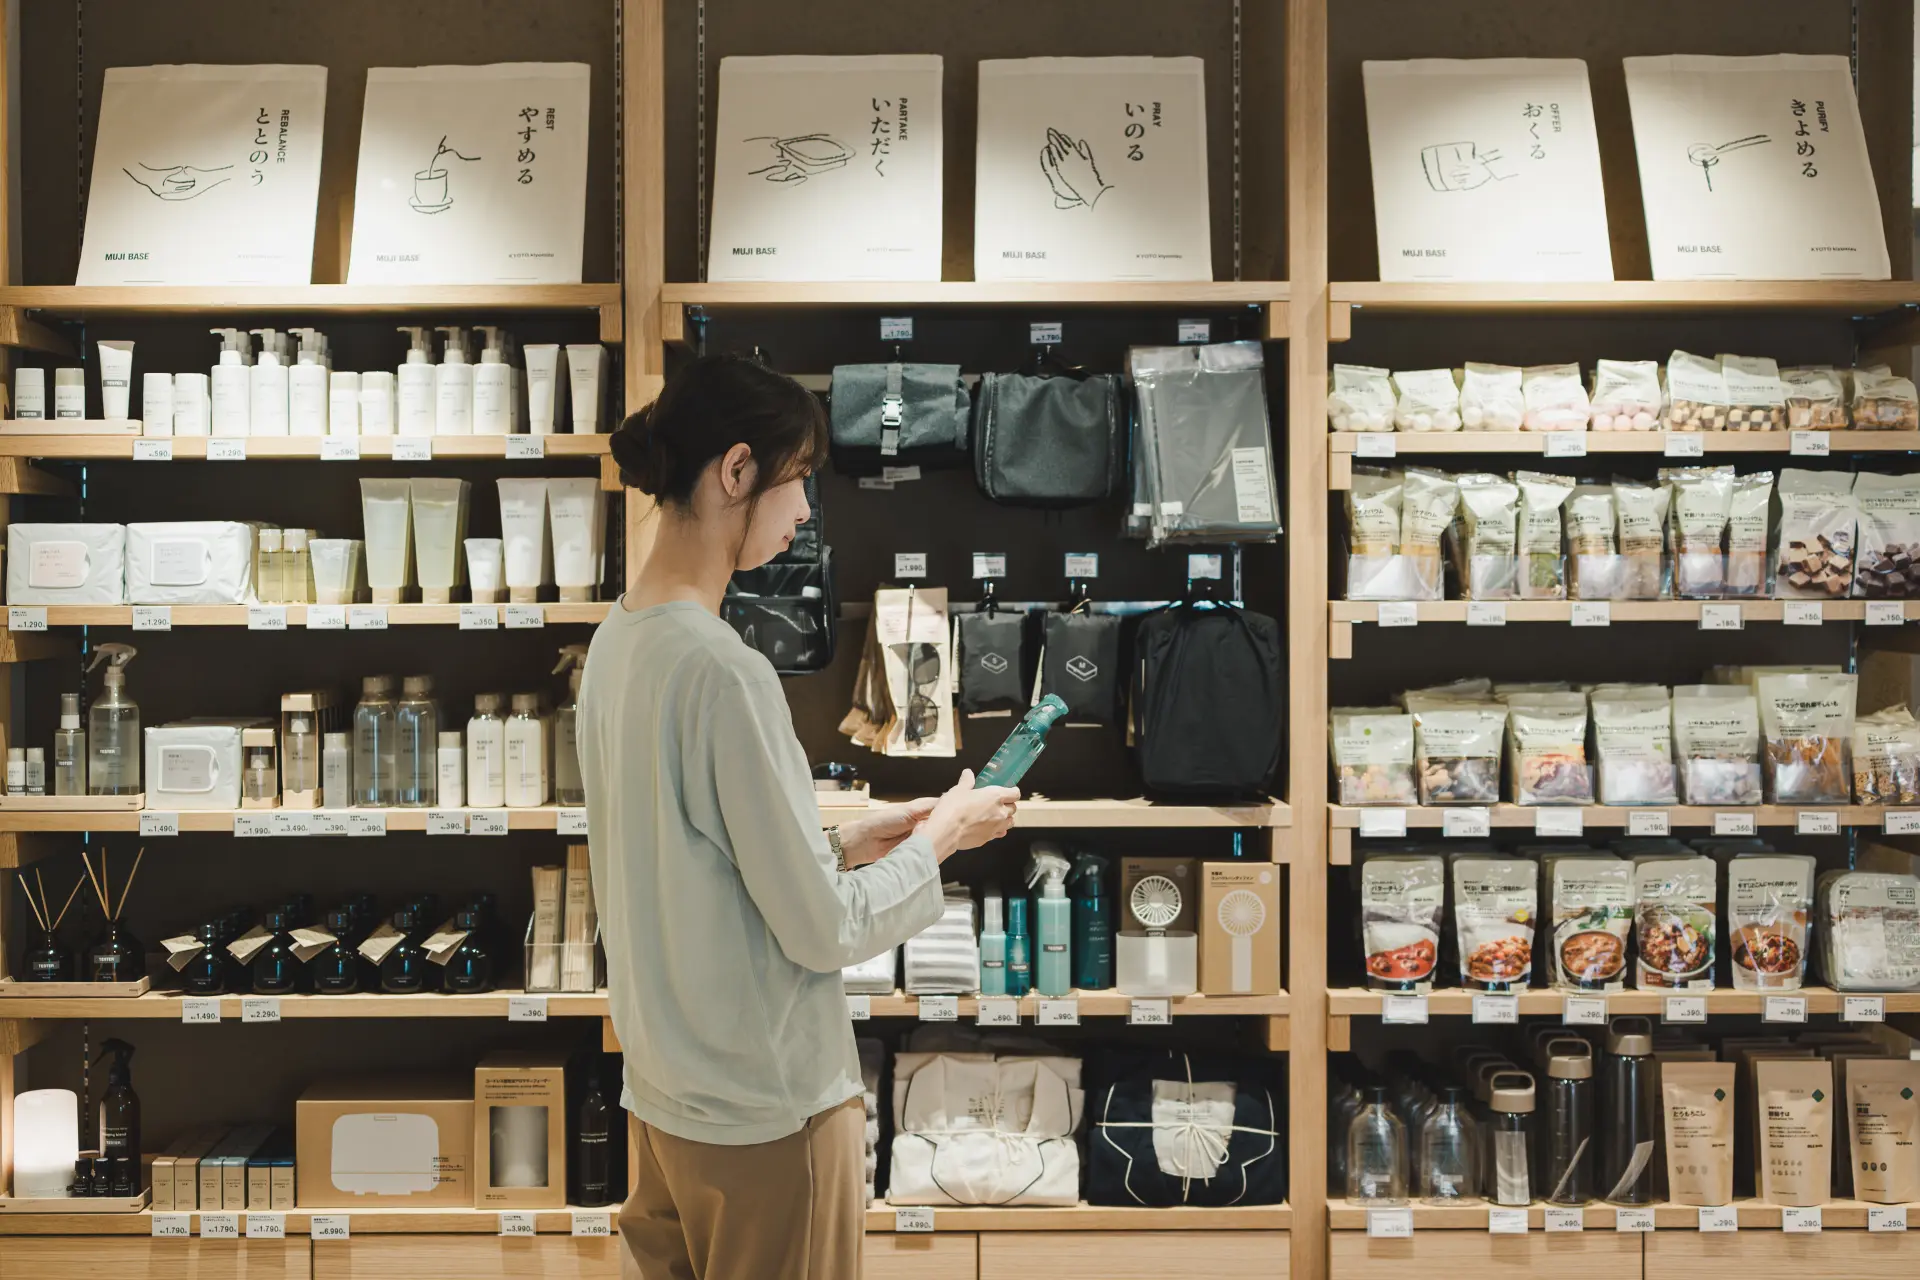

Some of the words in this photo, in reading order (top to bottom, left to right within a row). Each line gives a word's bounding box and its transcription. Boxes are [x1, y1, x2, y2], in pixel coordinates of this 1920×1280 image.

[545, 107, 555, 130] REST
[898, 97, 908, 141] PARTAKE
[1152, 101, 1162, 127] PRAY
[1550, 103, 1562, 133] OFFER
[1815, 100, 1829, 133] PURIFY
[276, 109, 290, 164] REBALANCE
[517, 106, 539, 185] やすめる
[870, 97, 891, 178] いただく
[1124, 102, 1145, 162] いのる
[1522, 102, 1546, 160] おくる
[1790, 98, 1818, 178] きよめる
[249, 107, 270, 187] ととのう
[105, 252, 126, 261] MUJI
[128, 252, 150, 261] BASE
[376, 254, 397, 262] MUJI
[398, 254, 420, 262] BASE
[732, 247, 753, 256] MUJI
[755, 247, 777, 255] BASE
[1002, 251, 1023, 259] MUJI
[1025, 251, 1047, 259] BASE
[1402, 249, 1423, 257] MUJI
[1425, 249, 1447, 257] BASE
[1677, 245, 1698, 253] MUJI
[1700, 245, 1723, 254] BASE
[526, 447, 539, 455] 750
